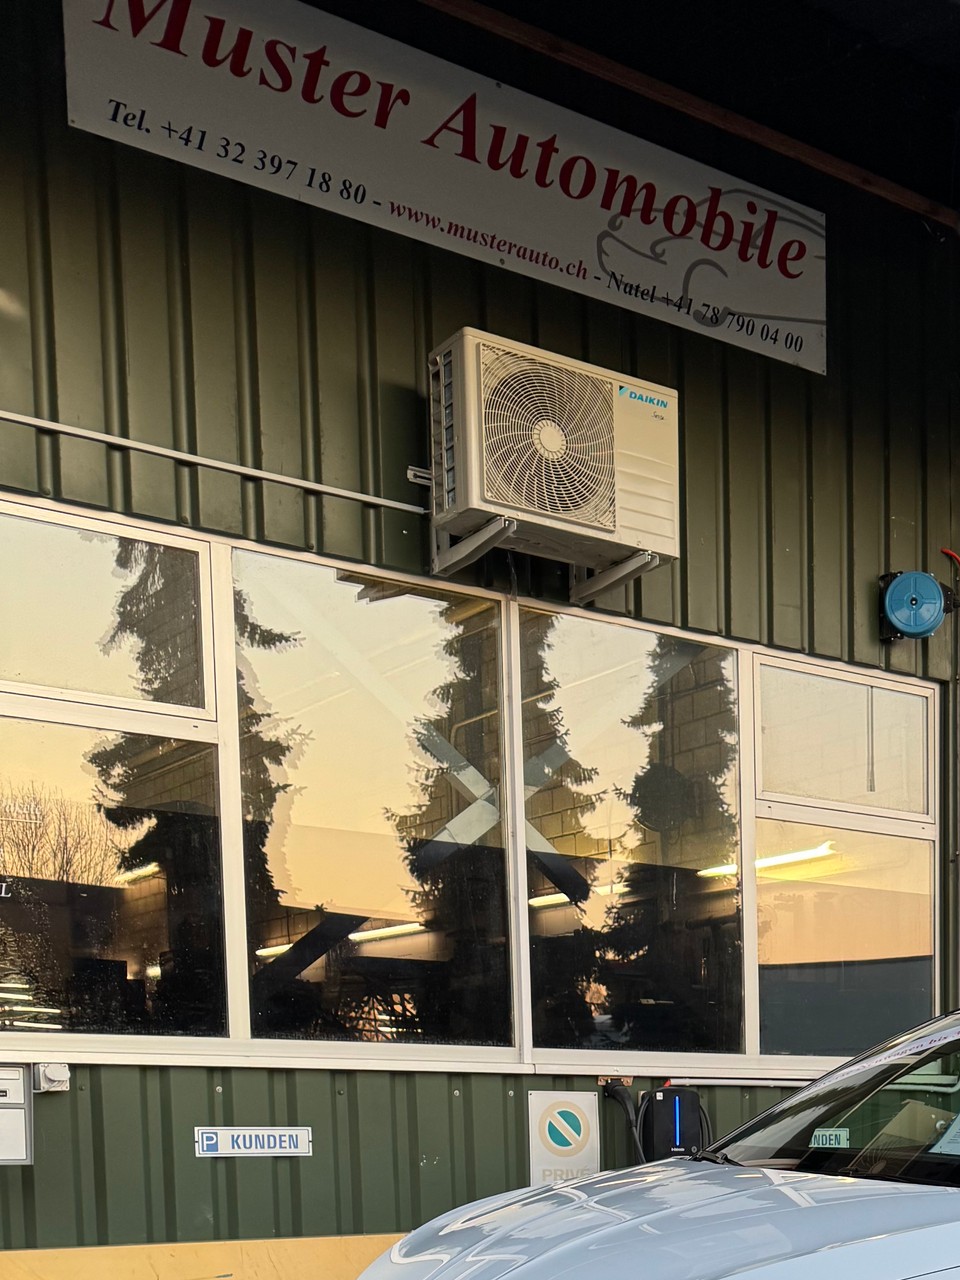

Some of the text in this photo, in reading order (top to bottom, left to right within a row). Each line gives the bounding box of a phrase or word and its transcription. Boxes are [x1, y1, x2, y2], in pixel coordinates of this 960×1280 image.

[92, 0, 807, 279] Muster Automobile
[108, 99, 151, 133] Tel.
[161, 121, 207, 151] +41
[217, 137, 246, 164] 32
[254, 150, 298, 180] 397
[306, 167, 331, 193] 18
[340, 179, 366, 204] 80
[390, 201, 588, 280] www.musterauto.ch
[608, 271, 656, 303] Natel
[663, 291, 694, 316] +41
[701, 303, 720, 325] 78
[727, 312, 755, 336] 790
[761, 324, 779, 345] 04
[785, 332, 804, 352] 00
[629, 391, 668, 408] DAIKIN
[231, 1134, 299, 1149] KUNDEN
